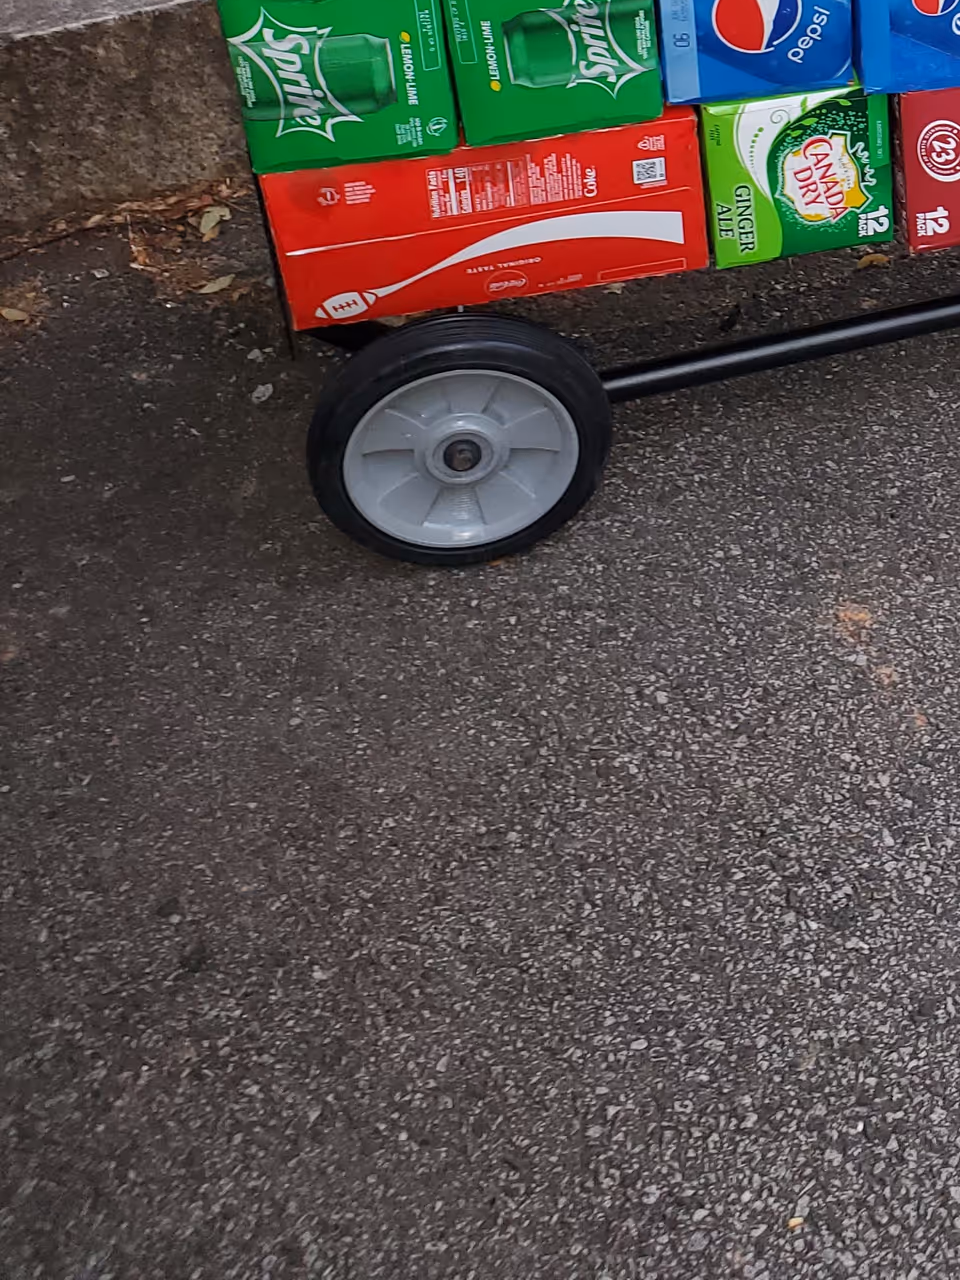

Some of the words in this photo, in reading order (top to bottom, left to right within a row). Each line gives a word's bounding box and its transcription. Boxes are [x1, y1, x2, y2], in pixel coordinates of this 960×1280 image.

[787, 6, 830, 64] pepsi
[261, 28, 321, 127] Sprite
[932, 140, 954, 164] 23
[456, 168, 466, 182] 140
[583, 168, 597, 196] Coke
[793, 169, 825, 208] DRY
[799, 137, 849, 223] CANADA
[715, 202, 732, 239] ALE
[732, 184, 756, 254] GINGER
[857, 213, 868, 237] PACK
[866, 205, 889, 235] 12
[916, 213, 926, 237] PACK
[926, 206, 949, 234] 12
[466, 265, 494, 273] TASTE
[497, 257, 542, 267] ORIGINAL
